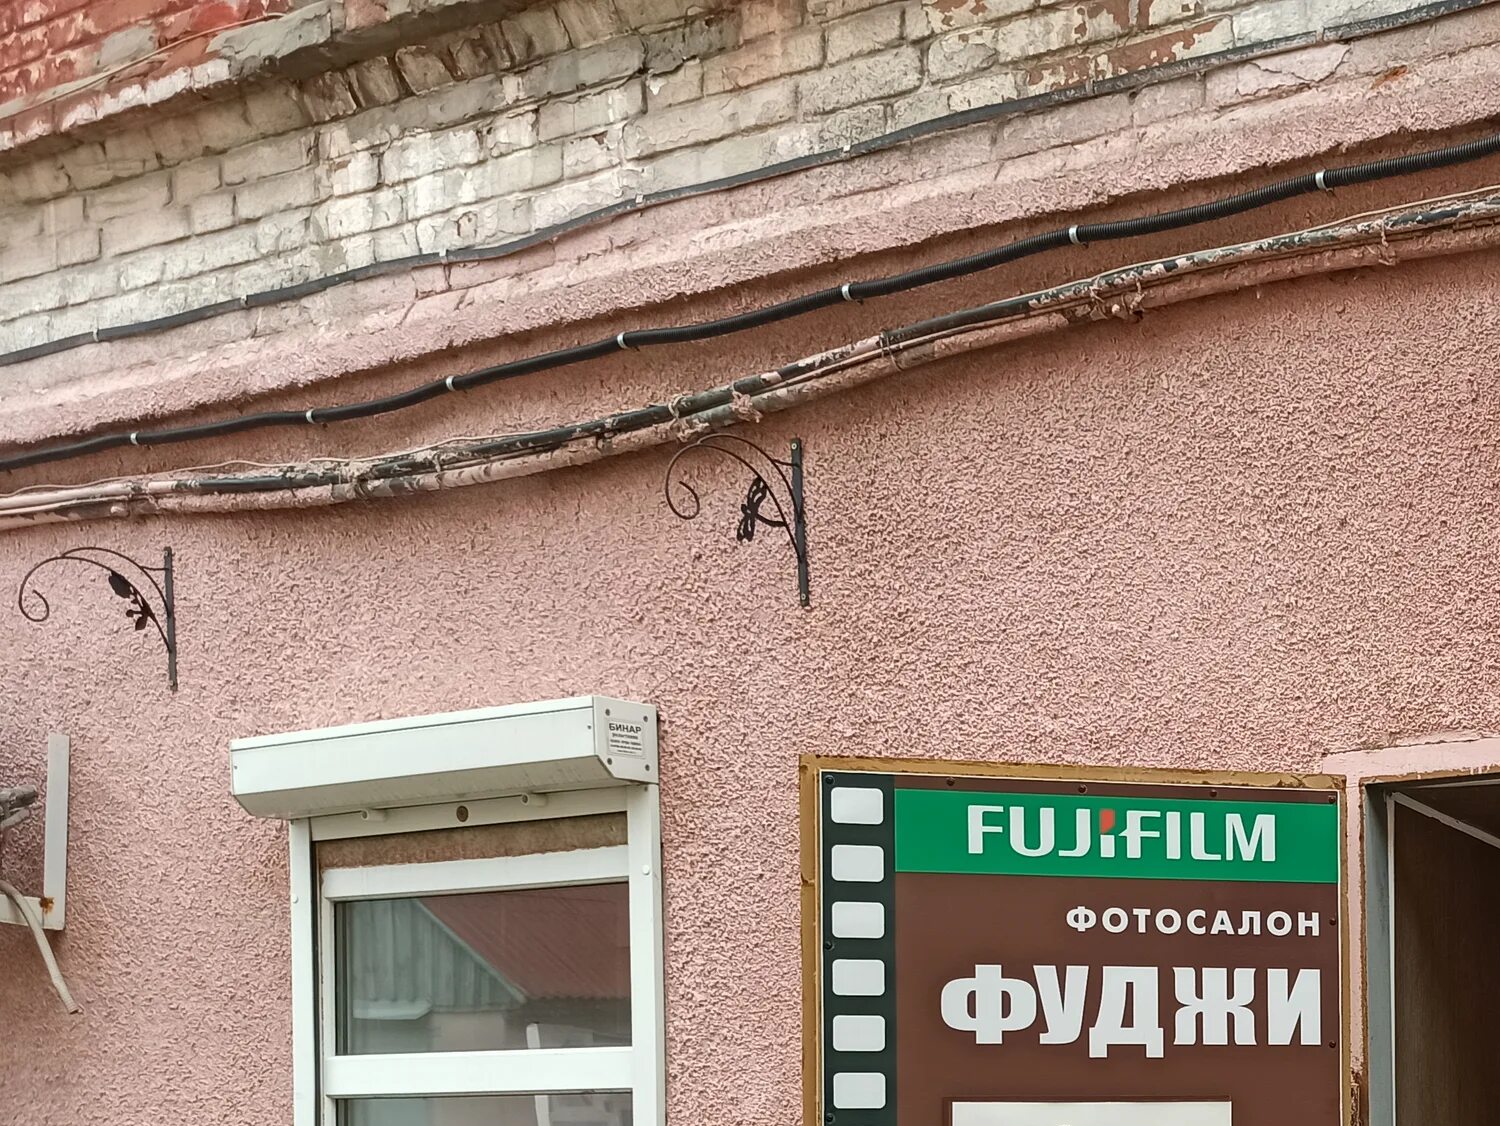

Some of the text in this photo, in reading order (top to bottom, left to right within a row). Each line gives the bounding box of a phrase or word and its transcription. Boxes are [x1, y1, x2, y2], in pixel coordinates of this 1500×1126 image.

[608, 722, 642, 734] БИНАР
[967, 804, 1276, 862] FUJIFILM
[1066, 905, 1320, 937] ФОТОСАЛОН
[940, 964, 1322, 1058] ФУДЖИ
